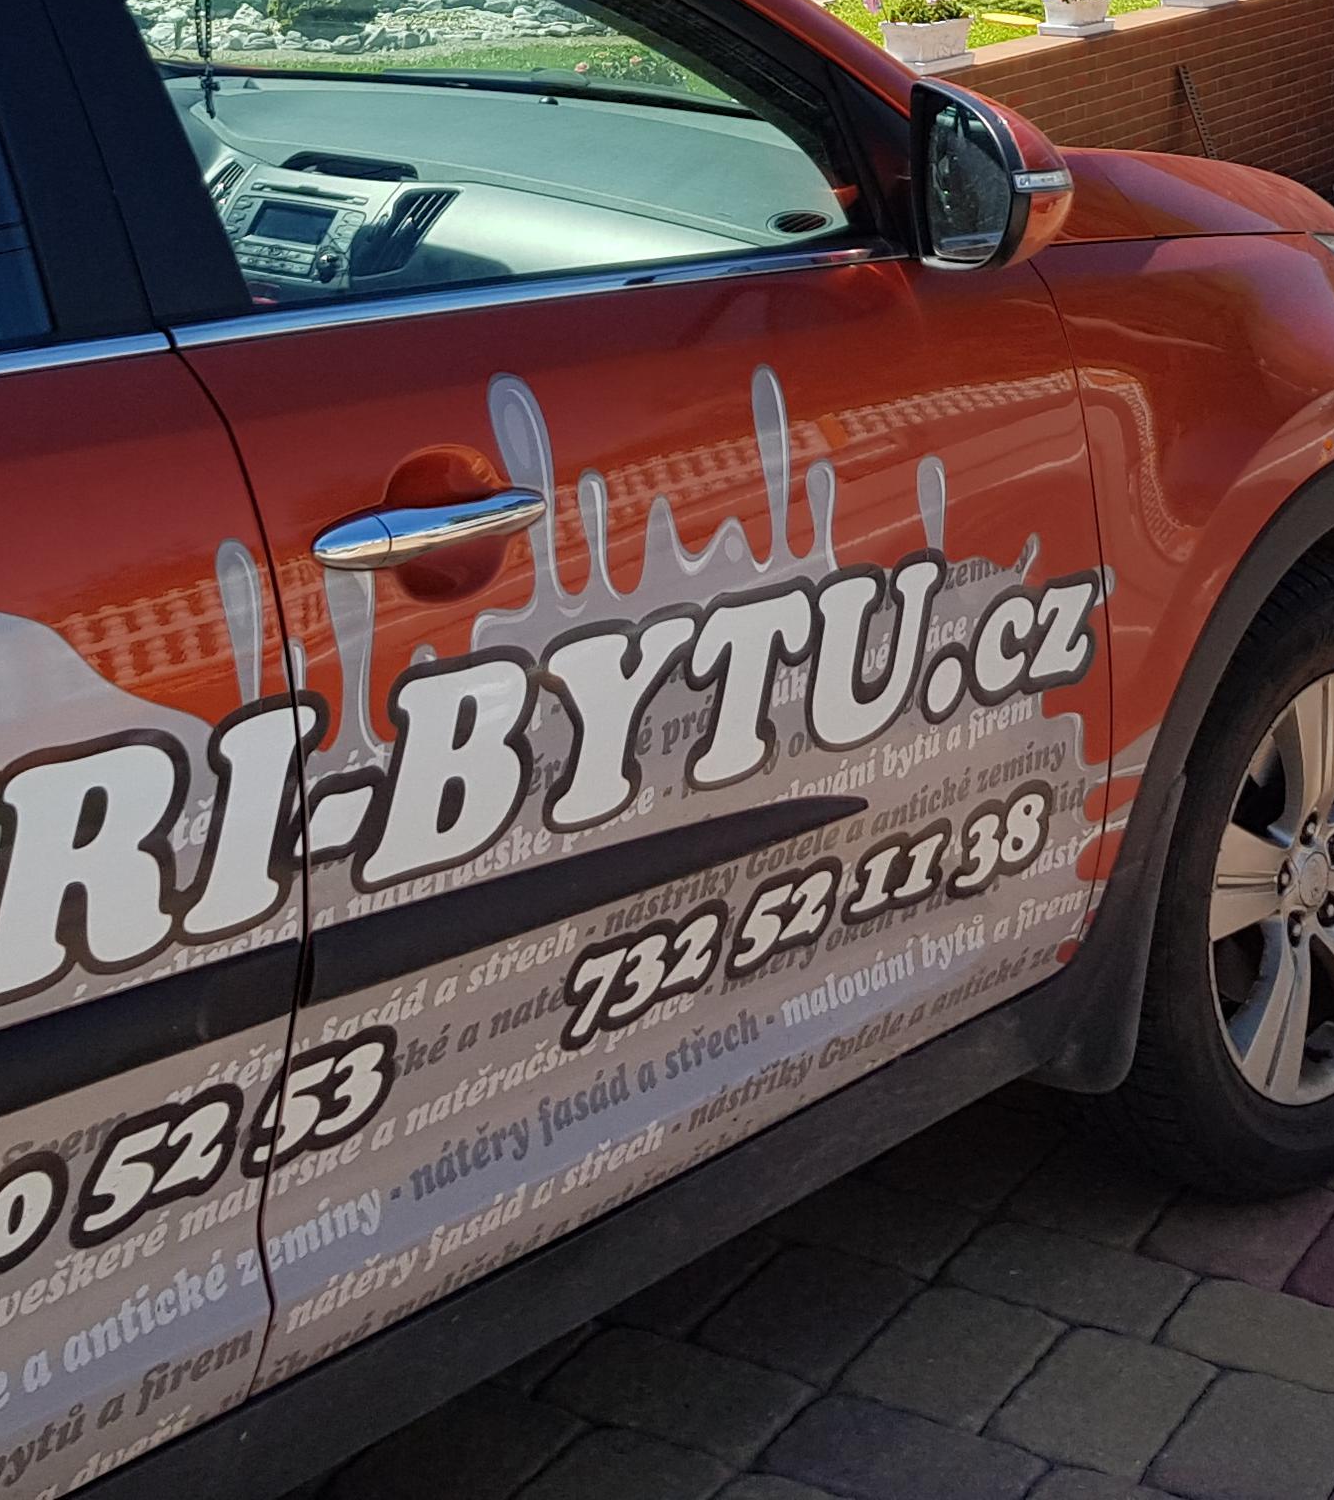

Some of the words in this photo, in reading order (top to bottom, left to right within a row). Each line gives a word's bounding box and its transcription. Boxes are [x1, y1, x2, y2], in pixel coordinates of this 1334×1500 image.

[882, 721, 941, 781] bytů
[967, 697, 1034, 750] firem
[434, 970, 457, 1008] a
[466, 920, 578, 995] střech
[746, 824, 839, 881] Gotele
[846, 821, 866, 845] a
[870, 767, 971, 837] antické
[565, 908, 723, 1043] 732
[729, 864, 837, 973] 52
[844, 828, 948, 918] 11
[950, 787, 1050, 894] 38
[22, 1349, 52, 1394] a
[62, 1248, 229, 1374] antické
[408, 1120, 531, 1202] nátěry
[538, 1068, 630, 1147] fasád
[637, 1060, 658, 1094] a
[664, 1008, 761, 1081] střech
[778, 951, 916, 1030] malování
[920, 915, 987, 970] bytů
[992, 920, 1009, 944] a
[1012, 890, 1085, 941] firem
[76, 1093, 236, 1239] 52
[245, 1035, 390, 1170] 53
[369, 1126, 395, 1153] a
[456, 1027, 479, 1053] a
[96, 1393, 127, 1430] a
[134, 1329, 254, 1418] firem
[285, 1246, 419, 1334] nátěry
[423, 1182, 527, 1272] fasád
[531, 1178, 553, 1211] a
[561, 1120, 665, 1194] střech
